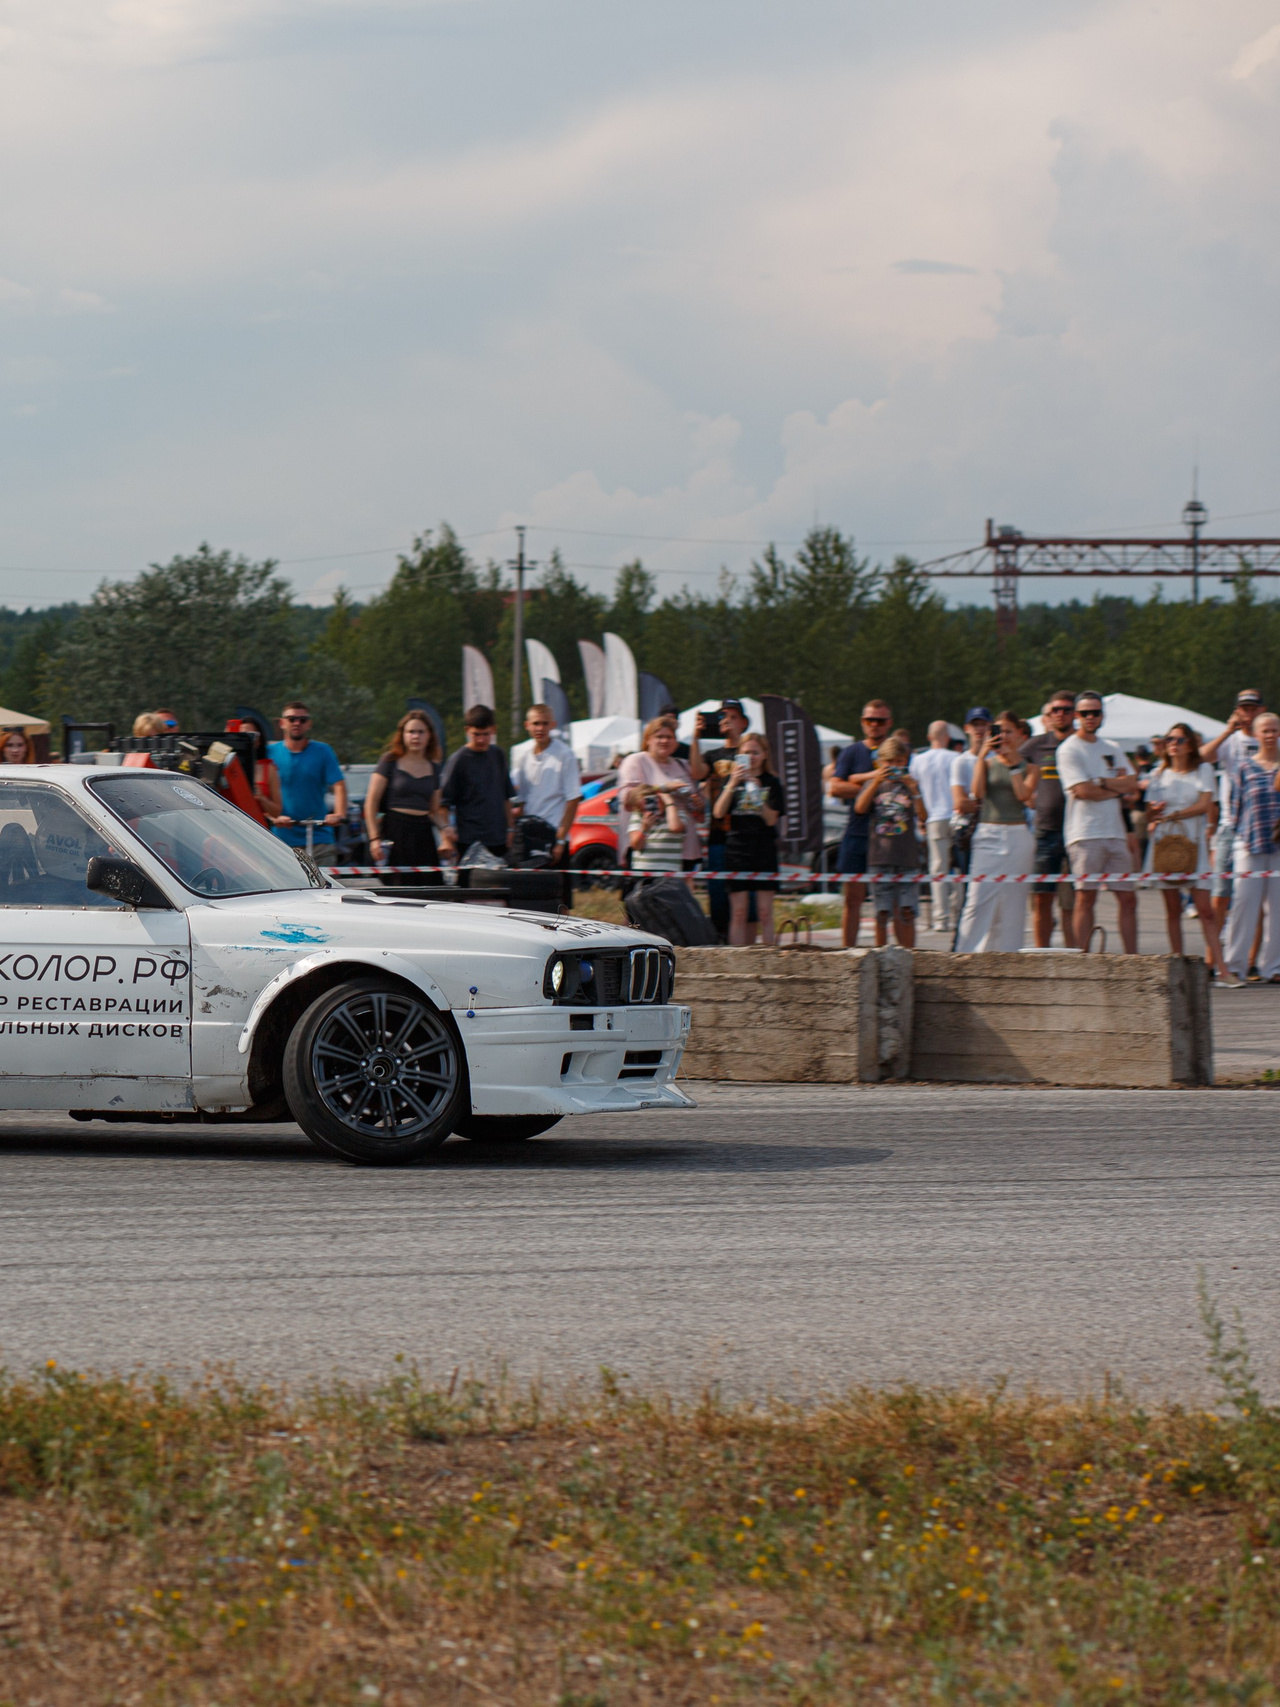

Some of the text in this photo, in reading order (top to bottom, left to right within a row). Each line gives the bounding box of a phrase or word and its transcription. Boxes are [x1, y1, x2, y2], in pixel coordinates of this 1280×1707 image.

[46, 833, 81, 849] AVOL
[17, 996, 183, 1014] РЕСТАВРАЦИИ
[88, 1023, 183, 1038] ДИСКОВ
